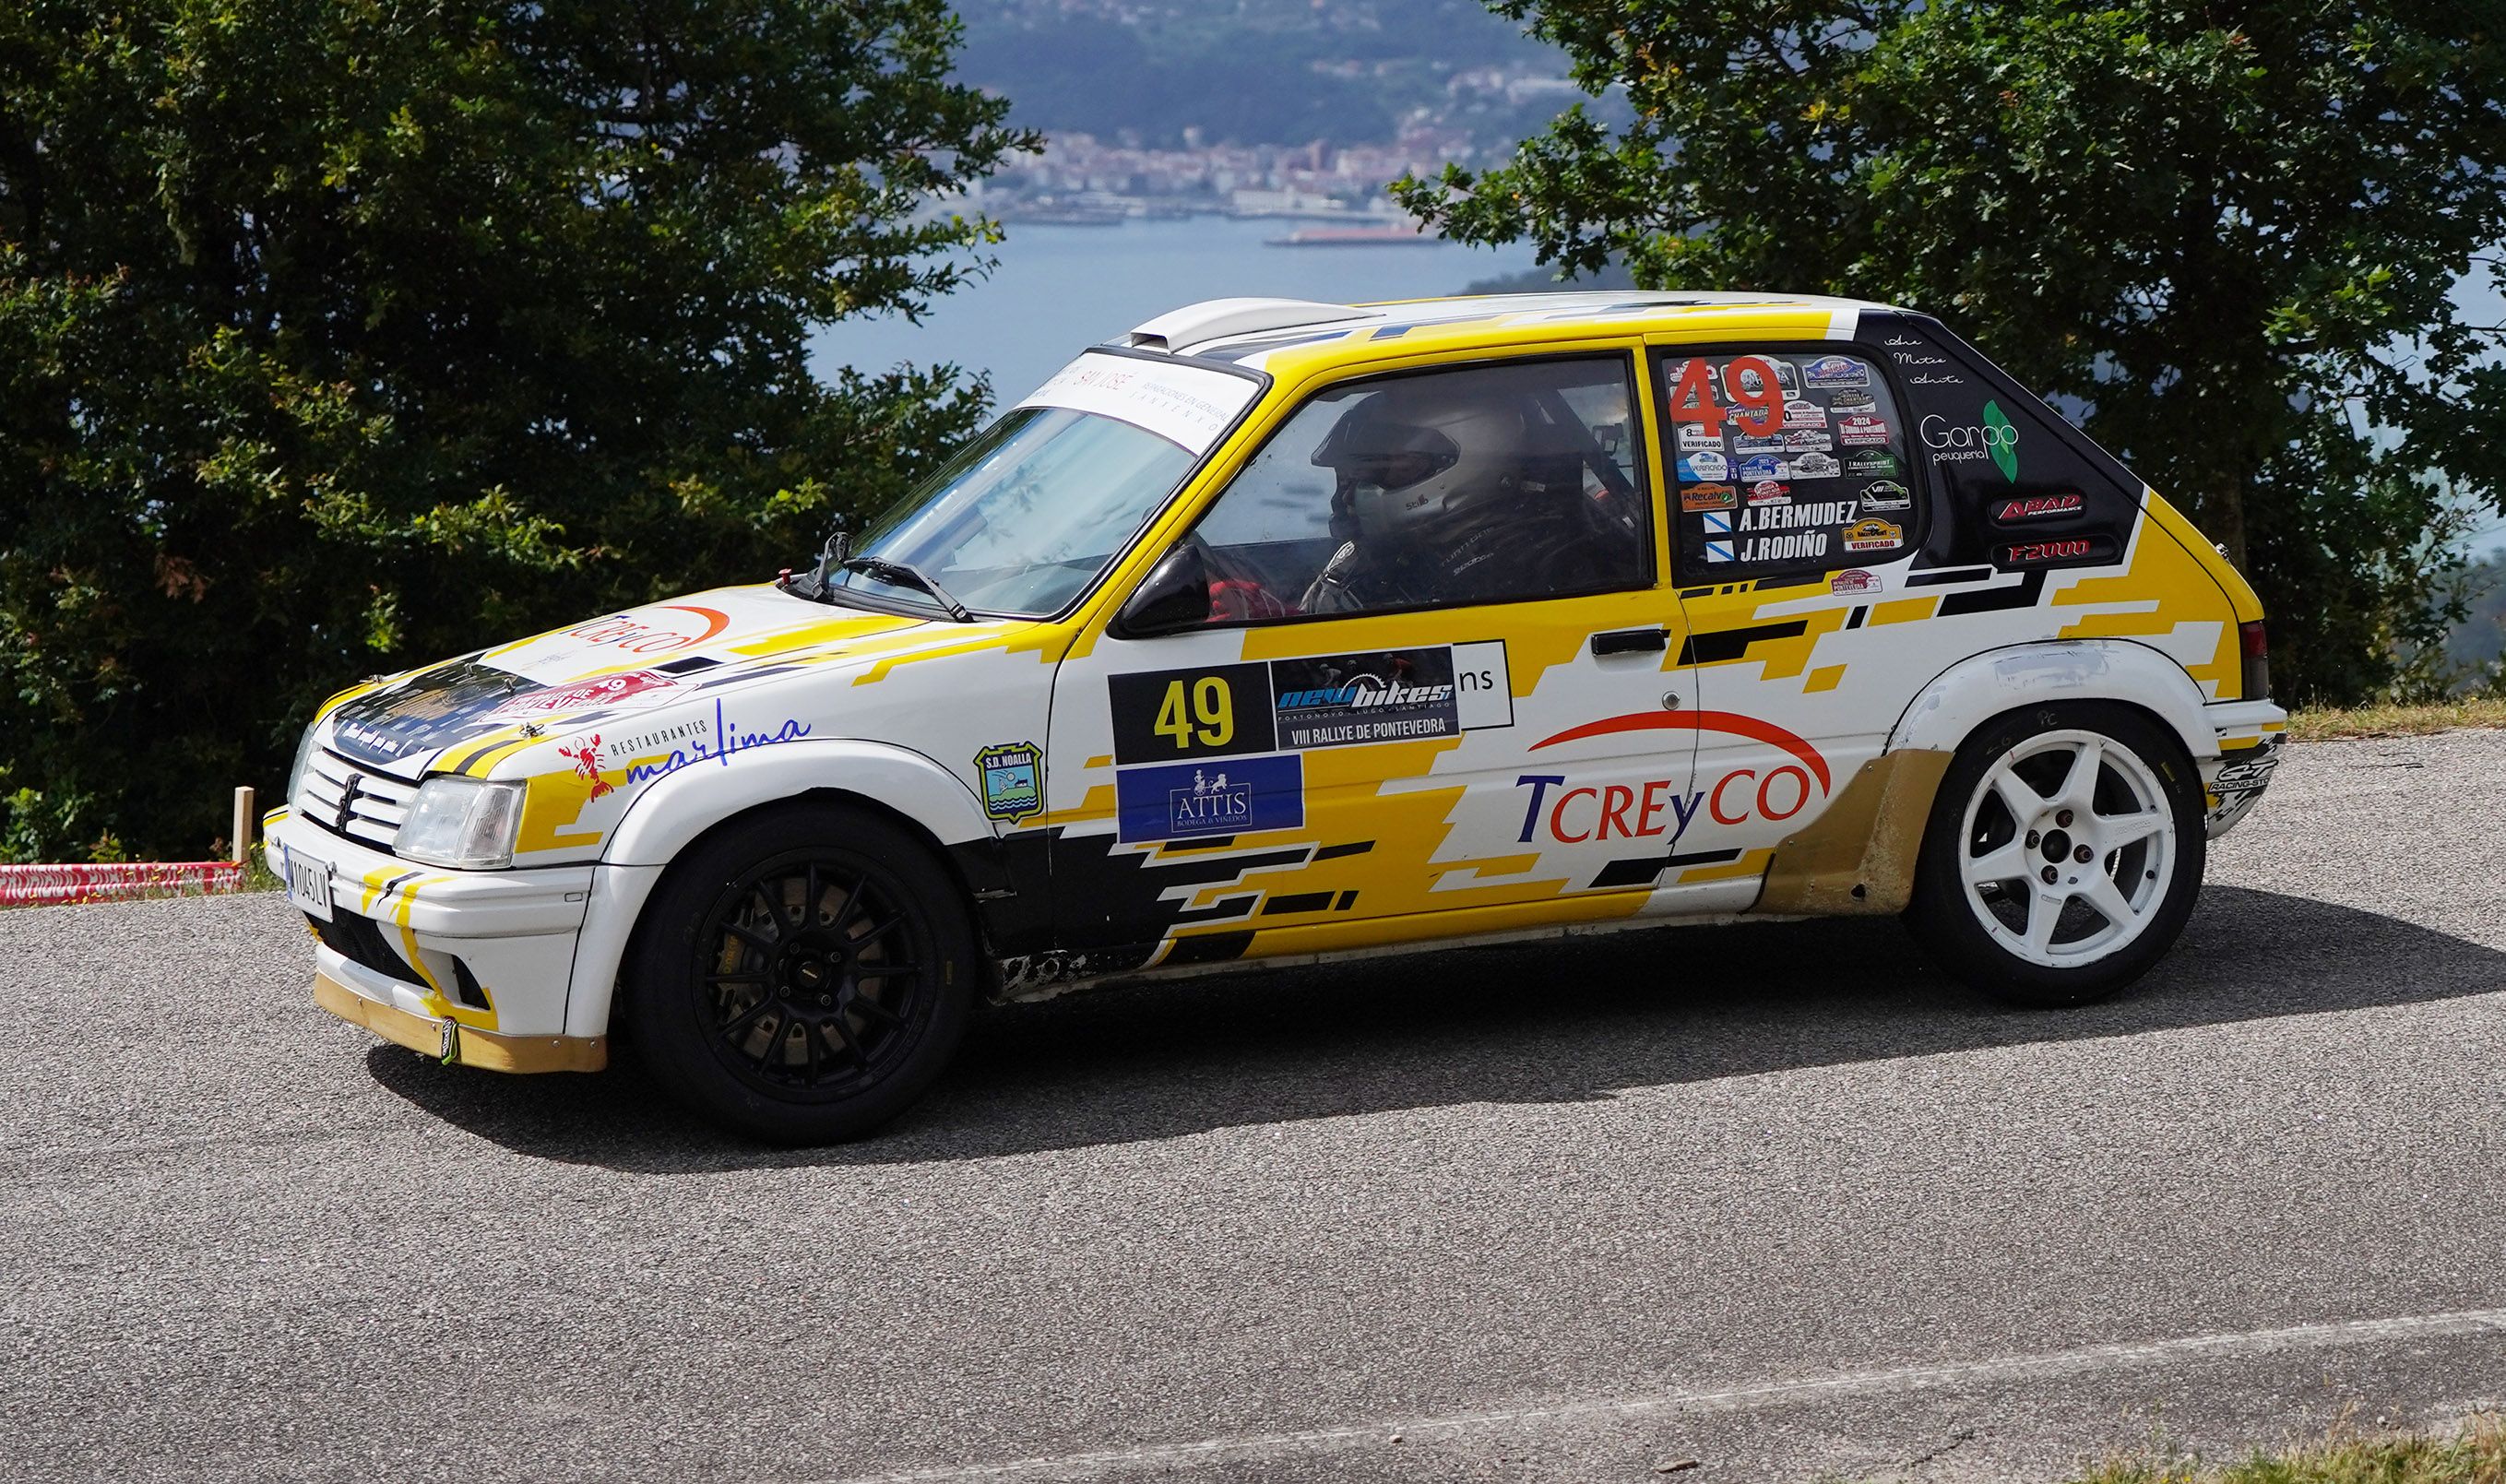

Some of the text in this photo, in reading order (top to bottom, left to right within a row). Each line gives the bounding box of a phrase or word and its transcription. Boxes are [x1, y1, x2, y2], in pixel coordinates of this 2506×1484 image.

[1669, 356, 1784, 438] 49
[1852, 417, 1871, 426] 2024
[1682, 440, 1722, 448] VERIFICADO
[1920, 414, 2019, 460] Garpo
[1739, 501, 1859, 532] A.BERMUDEZ
[2027, 505, 2083, 516] PERFORMANCE
[1740, 529, 1828, 563] J.RODIÑO
[1851, 540, 1894, 550] VERIFICADO
[2008, 540, 2090, 562] F2000
[1153, 675, 1234, 749] 49
[1355, 706, 1384, 716] LUGO
[1395, 701, 1451, 713] SANTIAGO
[611, 718, 707, 756] RESTAURANTES
[1291, 718, 1446, 746] VIII RALLYE DE PONTEVEDRA
[1003, 753, 1032, 767] NOALLA
[2217, 758, 2279, 782] GT
[1177, 791, 1247, 820] ATTIS
[1514, 765, 1811, 846] TCREyCO
[1177, 817, 1206, 827] BODEGA
